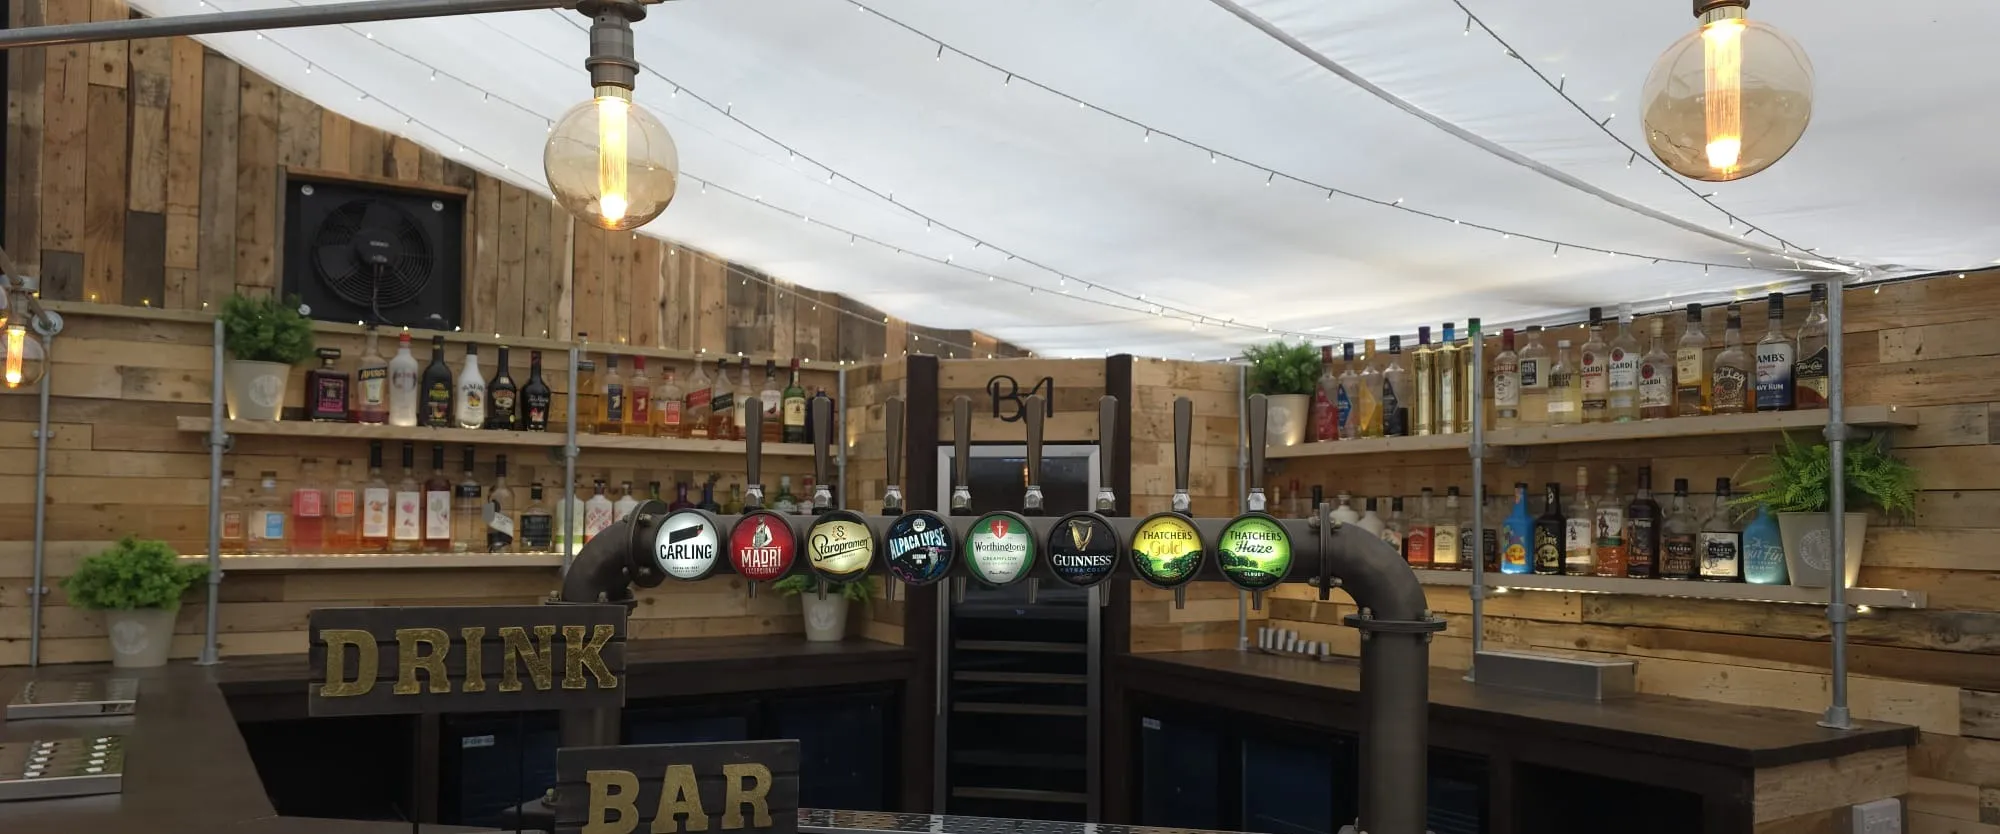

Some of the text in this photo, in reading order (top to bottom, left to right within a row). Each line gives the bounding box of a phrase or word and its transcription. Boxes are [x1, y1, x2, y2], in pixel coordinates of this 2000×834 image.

[1757, 352, 1785, 363] AMB'S
[1768, 383, 1784, 391] RUM
[1143, 530, 1192, 540] THATCHERS
[1230, 530, 1281, 541] THATCHERS
[811, 533, 869, 562] Staropramen
[889, 525, 947, 561] ALPACA LYPSE
[974, 541, 1026, 553] Worthington's
[1149, 540, 1183, 556] Gold
[1235, 541, 1273, 553] Haze
[660, 544, 712, 560] CARLING
[1053, 554, 1111, 567] GUINNESS
[319, 624, 618, 697] DRINK
[581, 763, 773, 834] BAR
